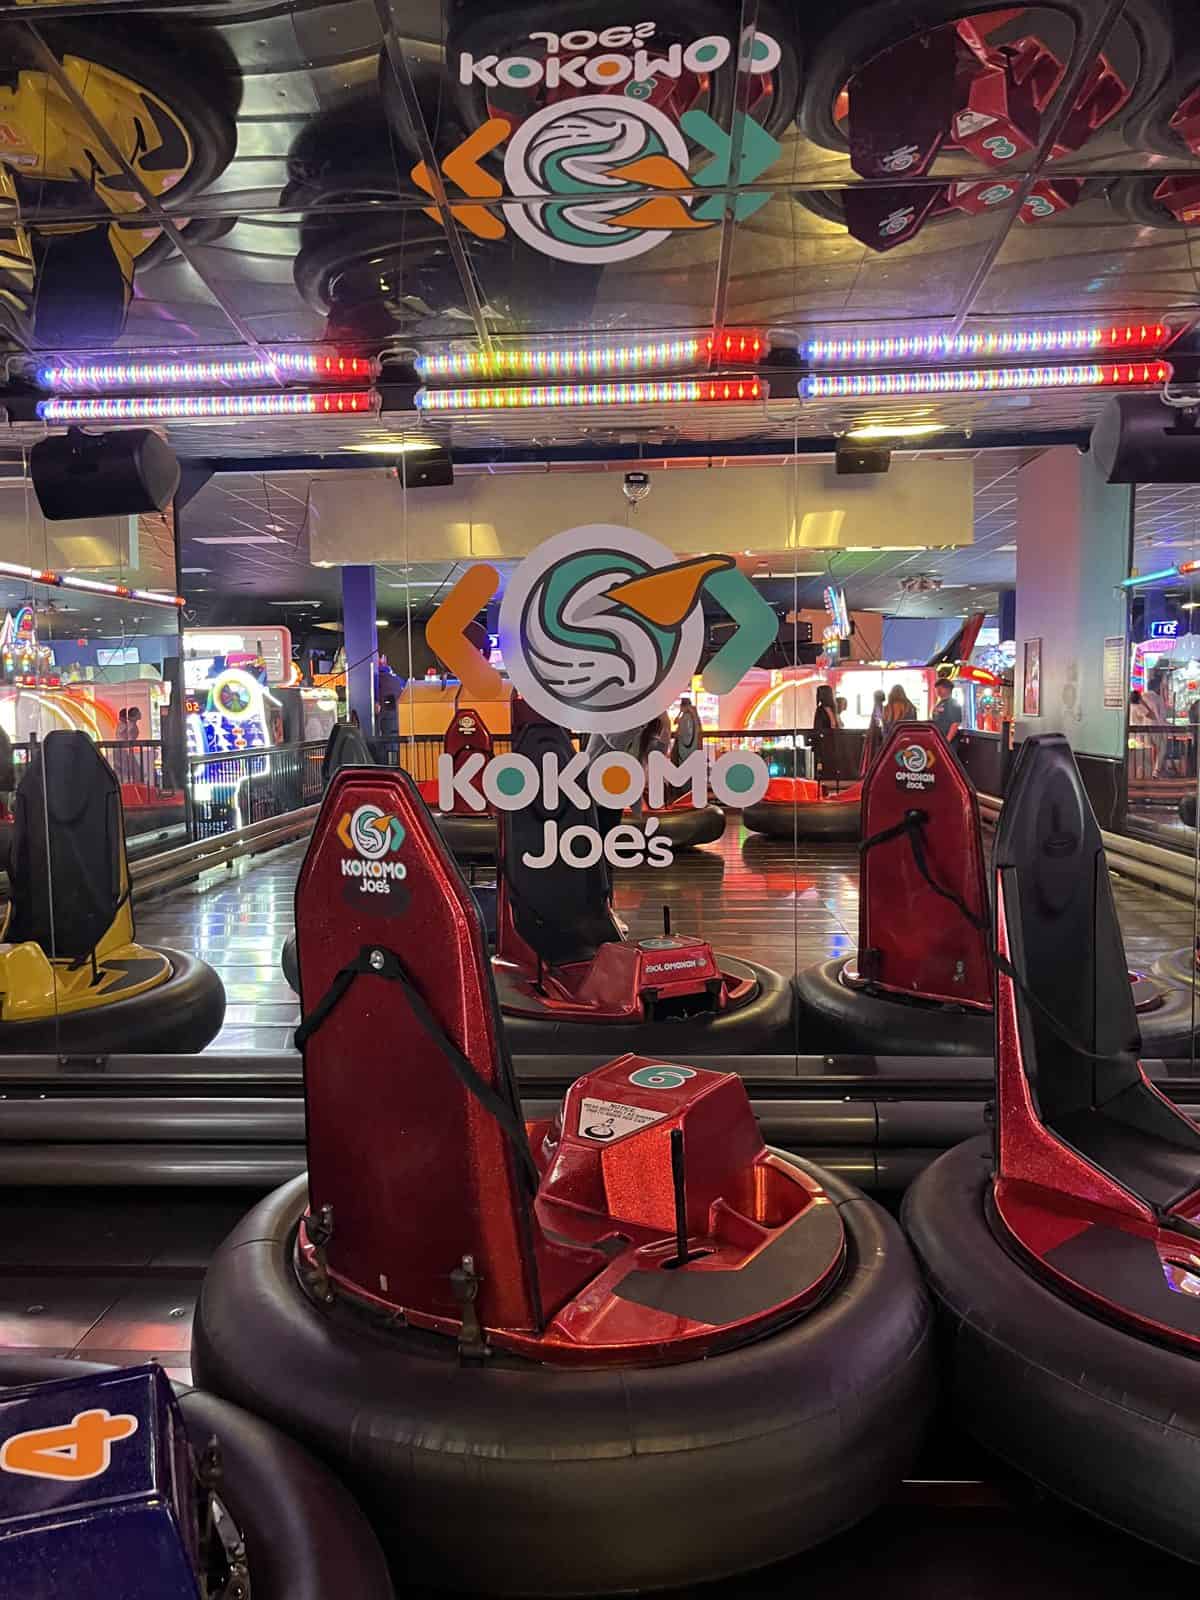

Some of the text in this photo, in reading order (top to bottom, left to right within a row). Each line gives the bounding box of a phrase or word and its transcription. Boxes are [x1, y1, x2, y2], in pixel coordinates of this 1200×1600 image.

[438, 751, 769, 811] KOKOMO
[341, 859, 407, 879] KOKOMO
[522, 817, 674, 869] Joe's
[359, 878, 390, 893] Joe's
[0, 1408, 138, 1481] 4
